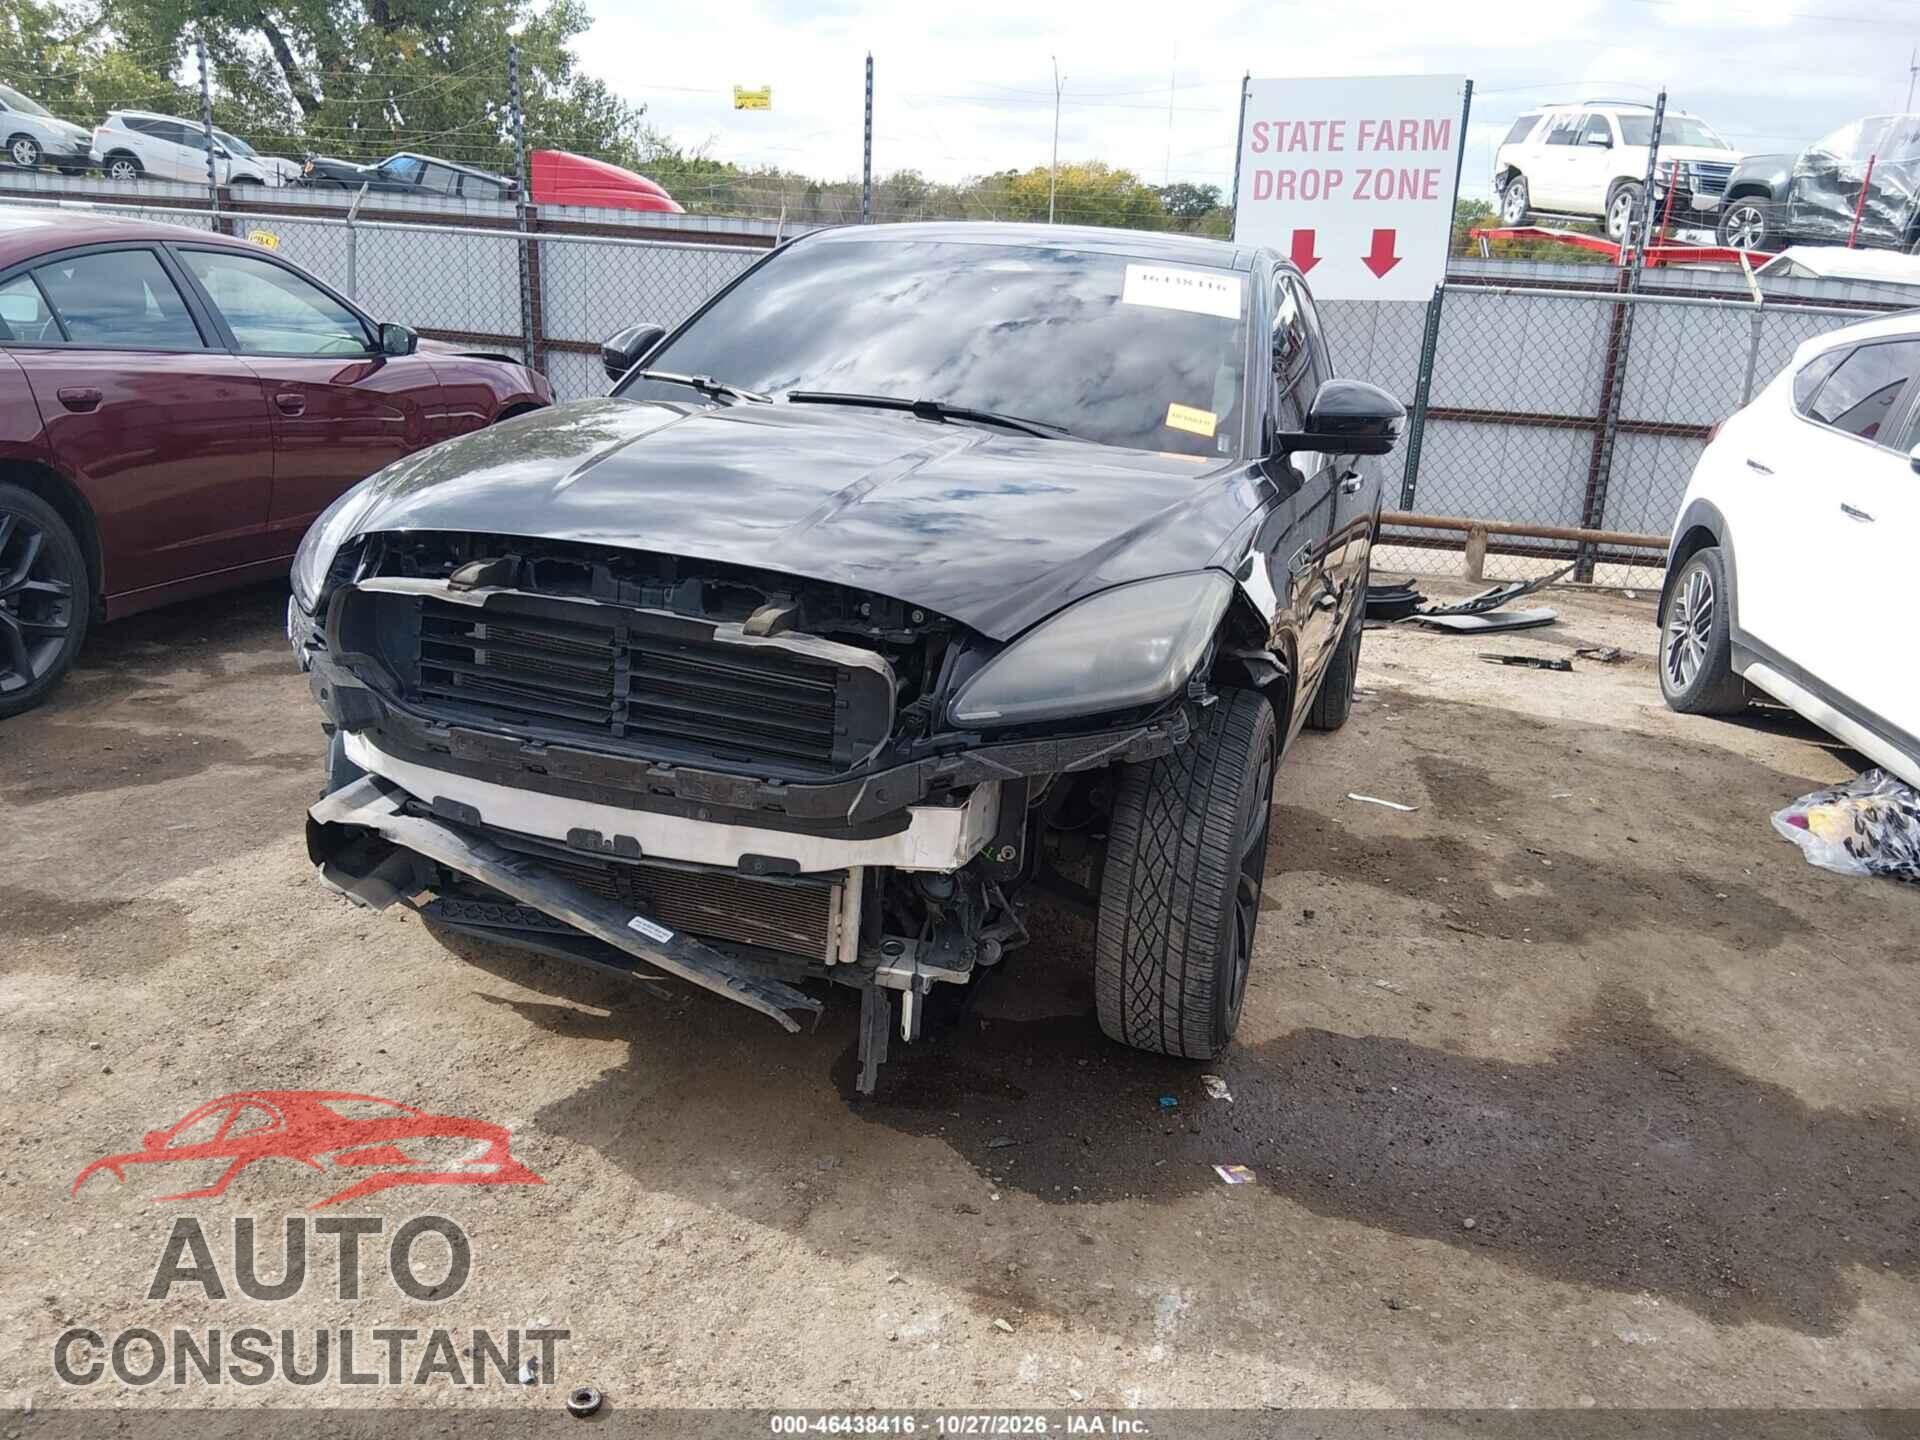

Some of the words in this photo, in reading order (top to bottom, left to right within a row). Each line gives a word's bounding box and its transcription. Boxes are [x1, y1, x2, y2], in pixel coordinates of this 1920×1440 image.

[1252, 120, 1346, 153] STATE
[1357, 118, 1453, 151] FARM
[1253, 169, 1343, 201] DROP
[1352, 168, 1441, 200] ZONE
